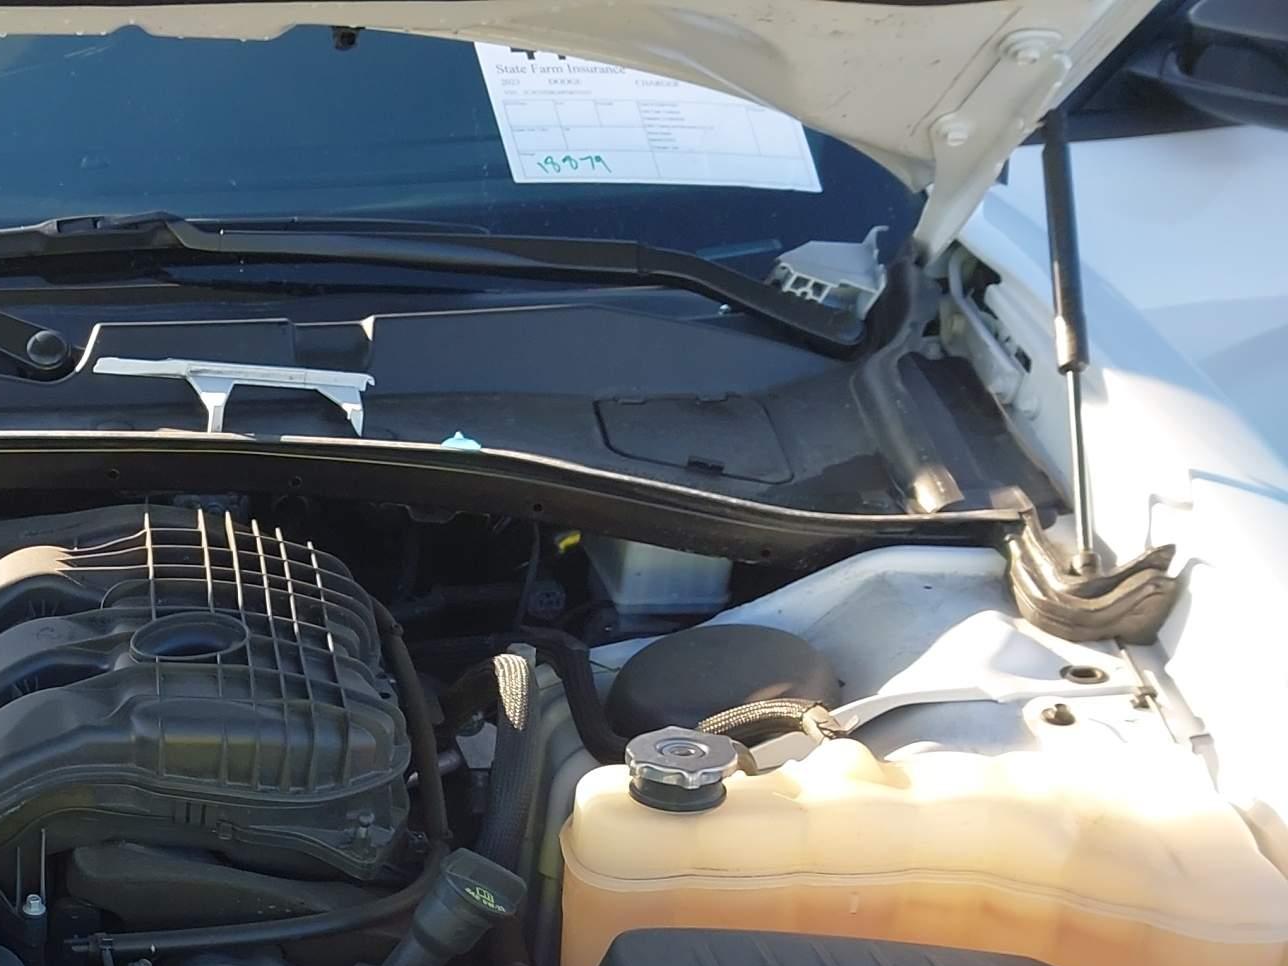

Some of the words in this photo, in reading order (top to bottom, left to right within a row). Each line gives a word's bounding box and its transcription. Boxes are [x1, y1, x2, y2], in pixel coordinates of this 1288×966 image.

[495, 64, 527, 74] State
[531, 64, 563, 74] Farm
[567, 64, 626, 75] Insurance
